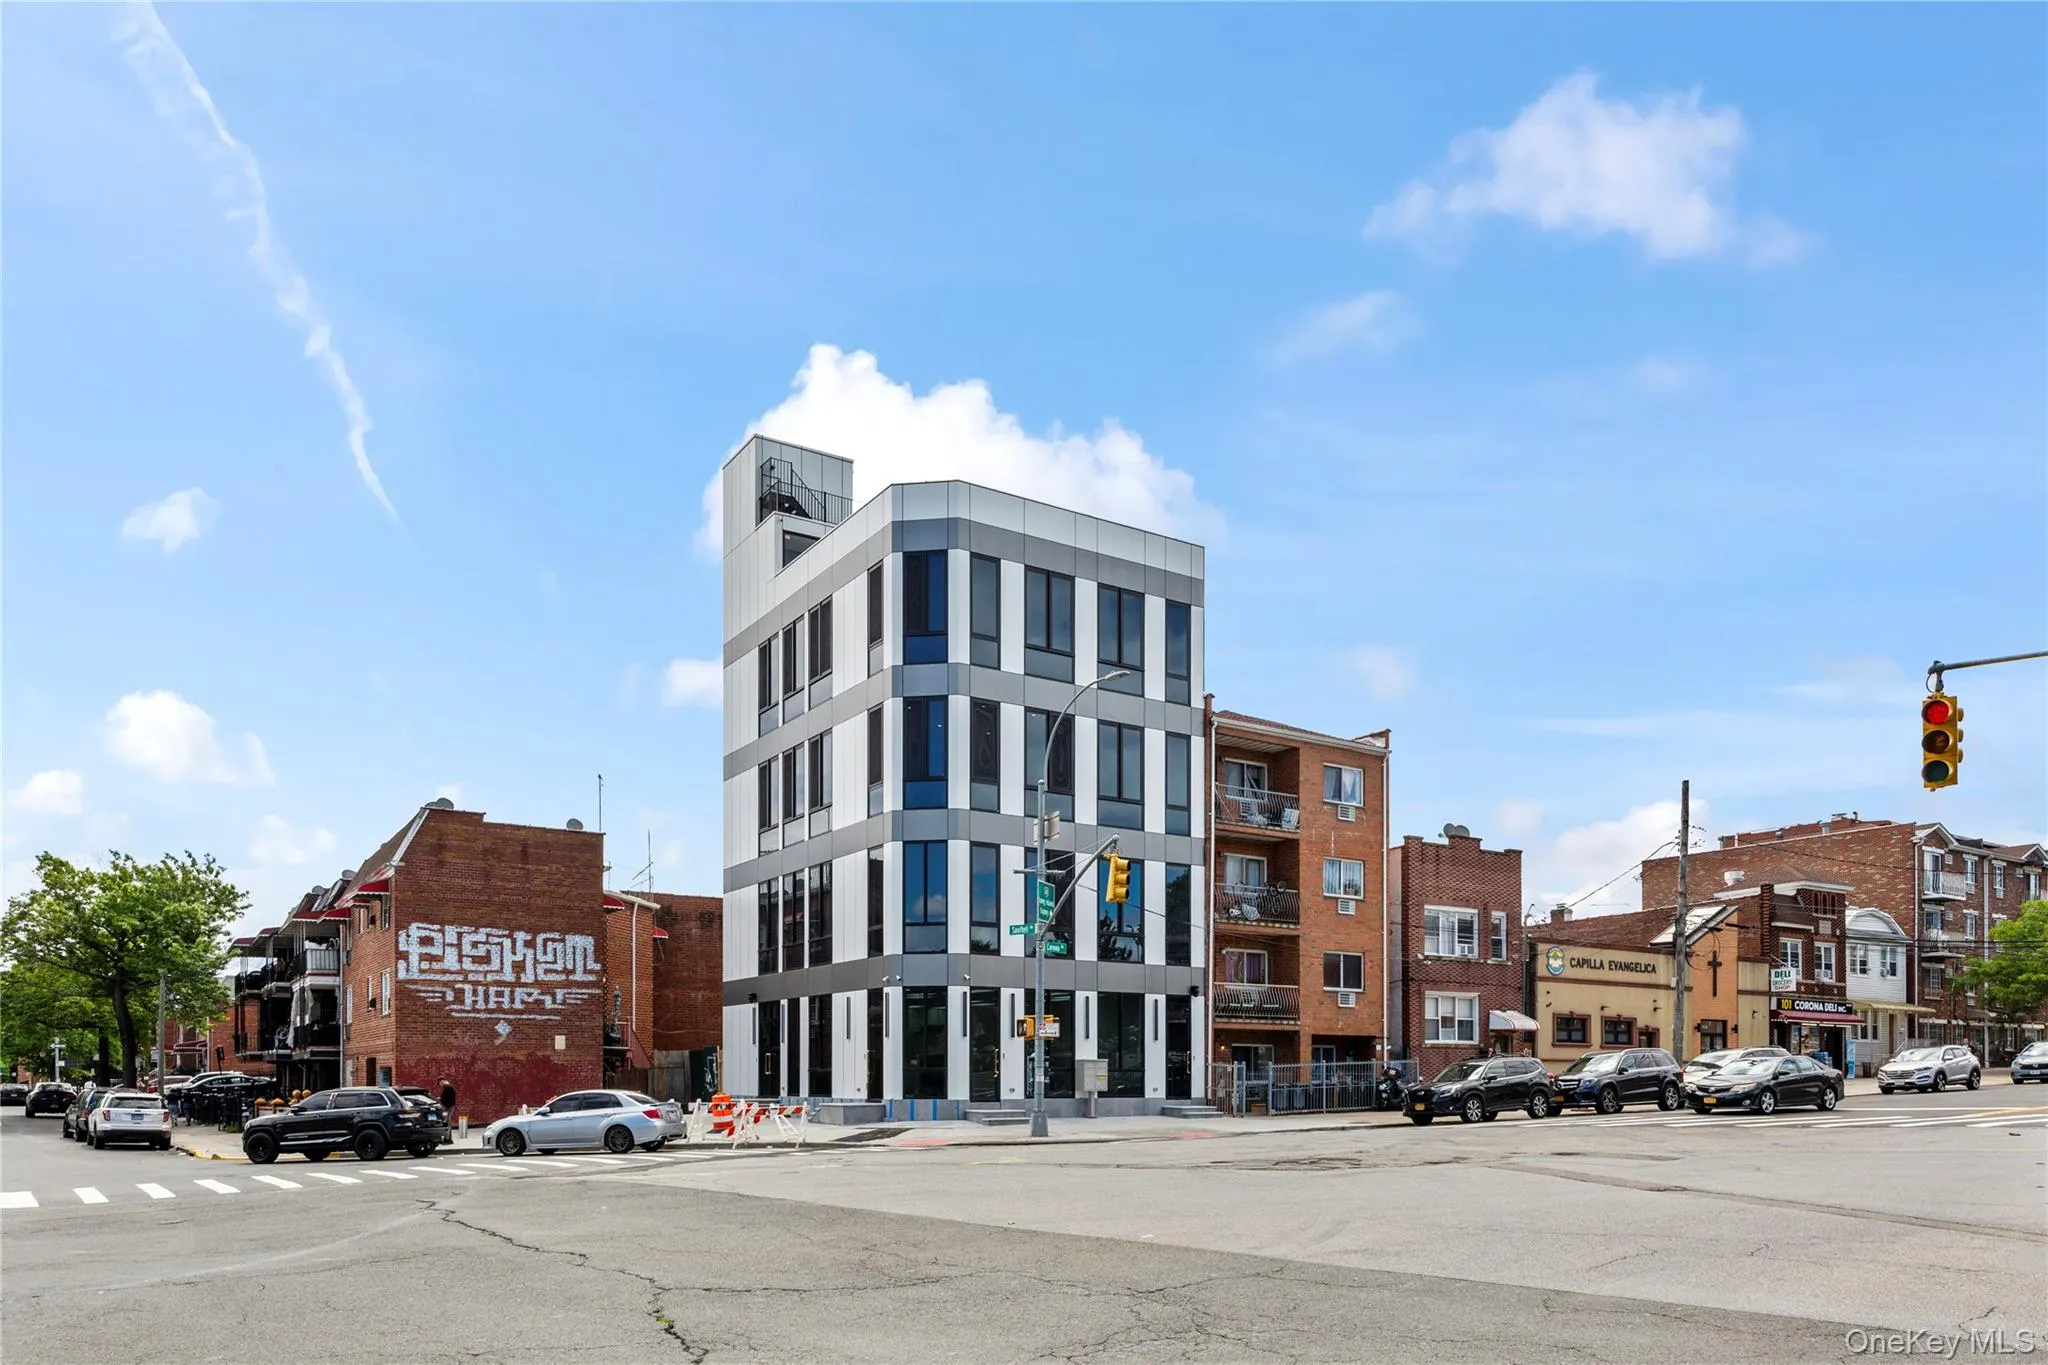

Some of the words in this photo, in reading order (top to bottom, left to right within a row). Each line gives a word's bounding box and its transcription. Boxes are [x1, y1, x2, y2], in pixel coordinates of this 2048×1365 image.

[1570, 957, 1605, 970] CAPILLA
[1608, 960, 1657, 974] EVANGELICA
[1774, 970, 1791, 979] DELI
[1781, 999, 1792, 1010] 101
[1794, 1000, 1824, 1012] CORONA
[1824, 1003, 1838, 1013] DELI
